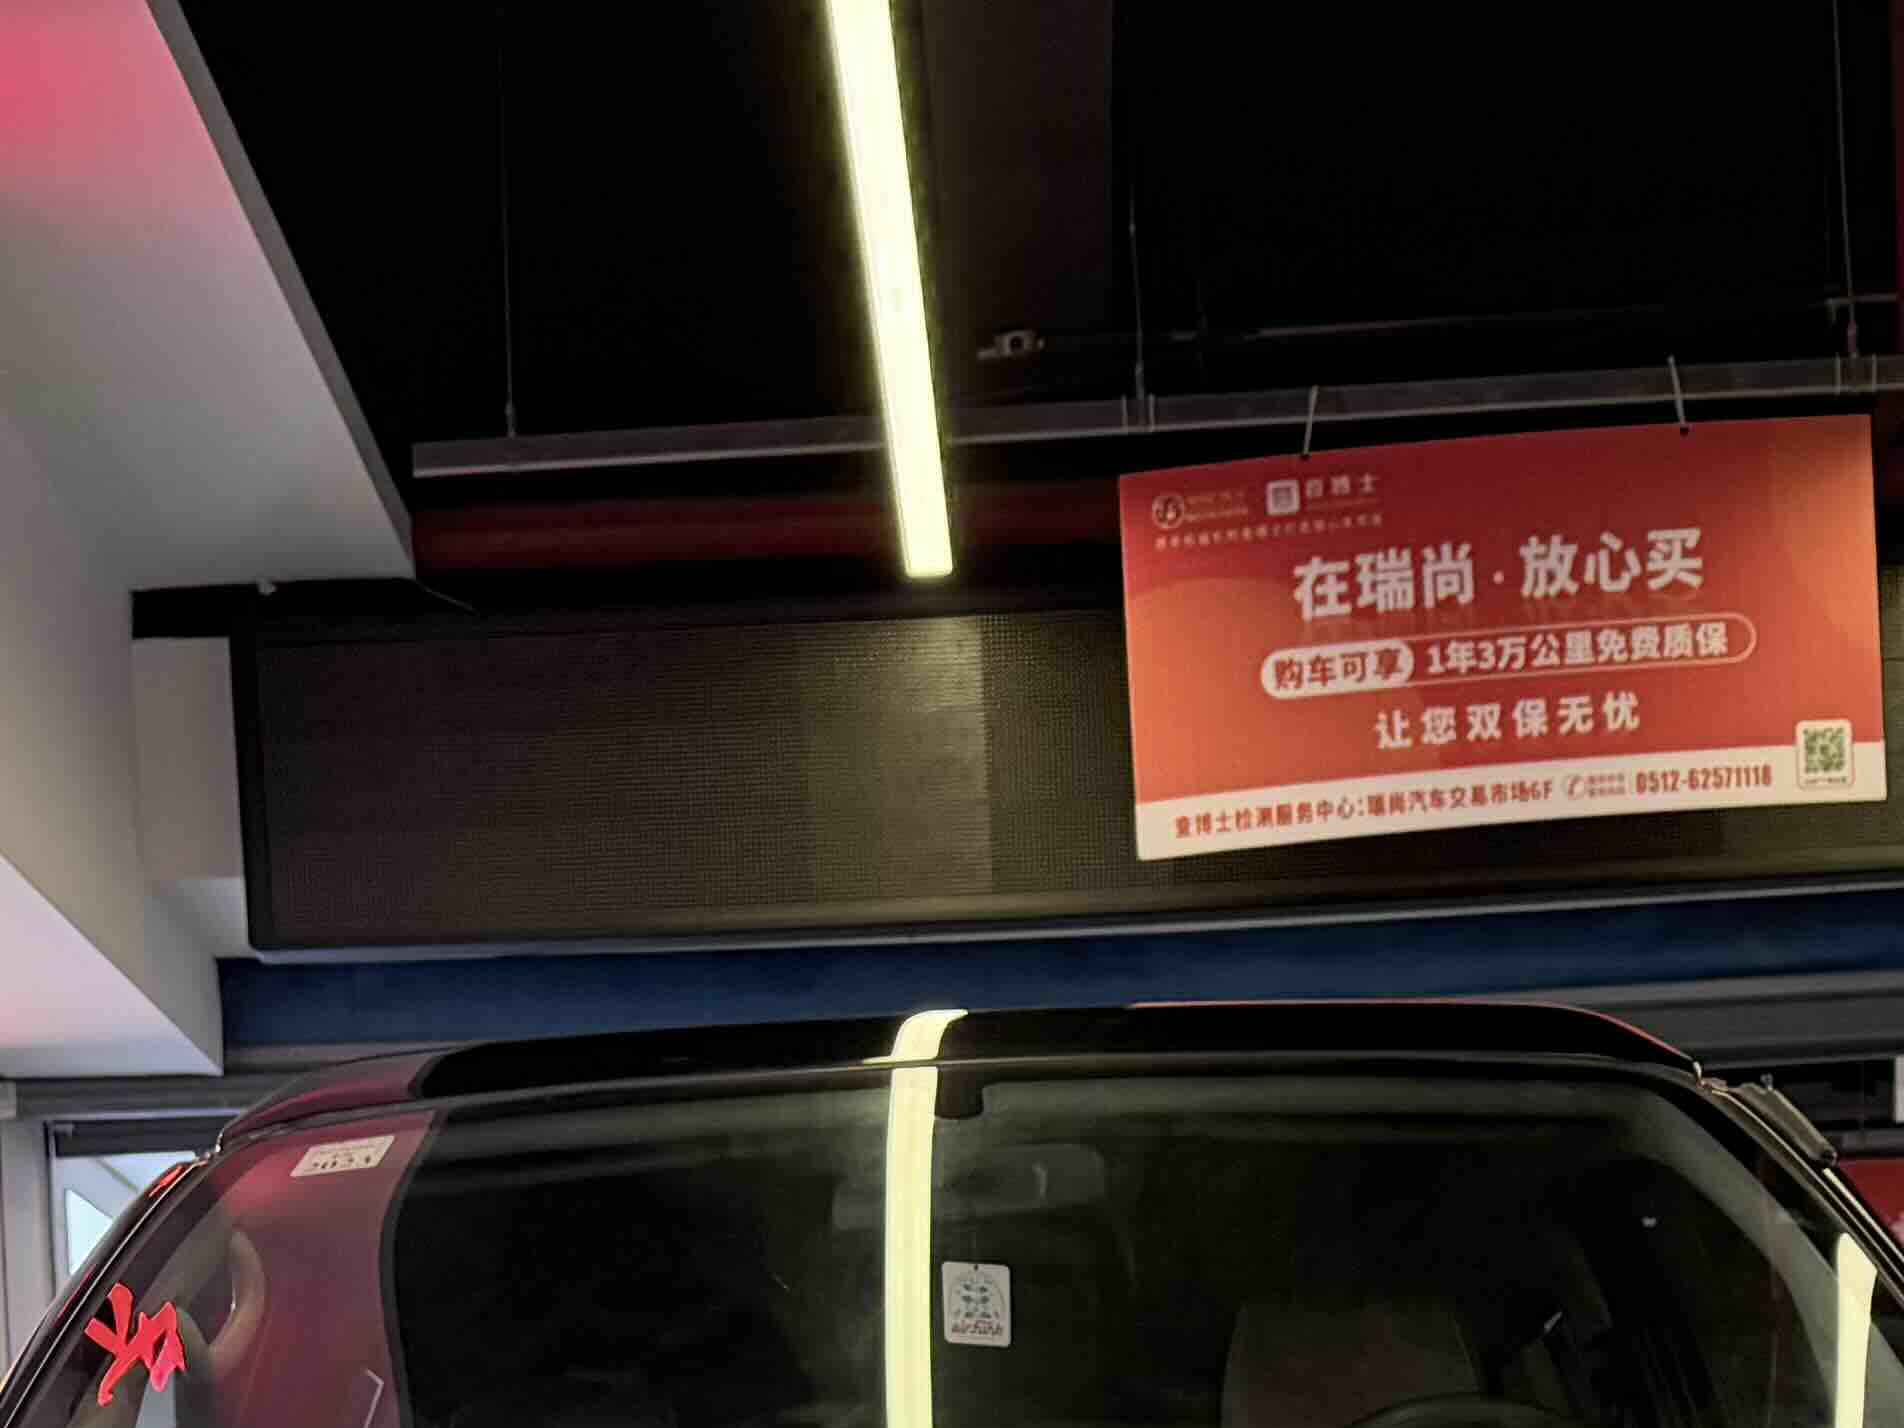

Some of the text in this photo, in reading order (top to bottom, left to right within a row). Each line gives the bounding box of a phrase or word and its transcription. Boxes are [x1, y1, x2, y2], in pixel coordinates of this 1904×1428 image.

[1295, 527, 1706, 620] 在瑞尚·放心买
[1274, 622, 1730, 690] 购车可享 1年3万公里免费质保
[1375, 691, 1642, 750] 让您双保无忧
